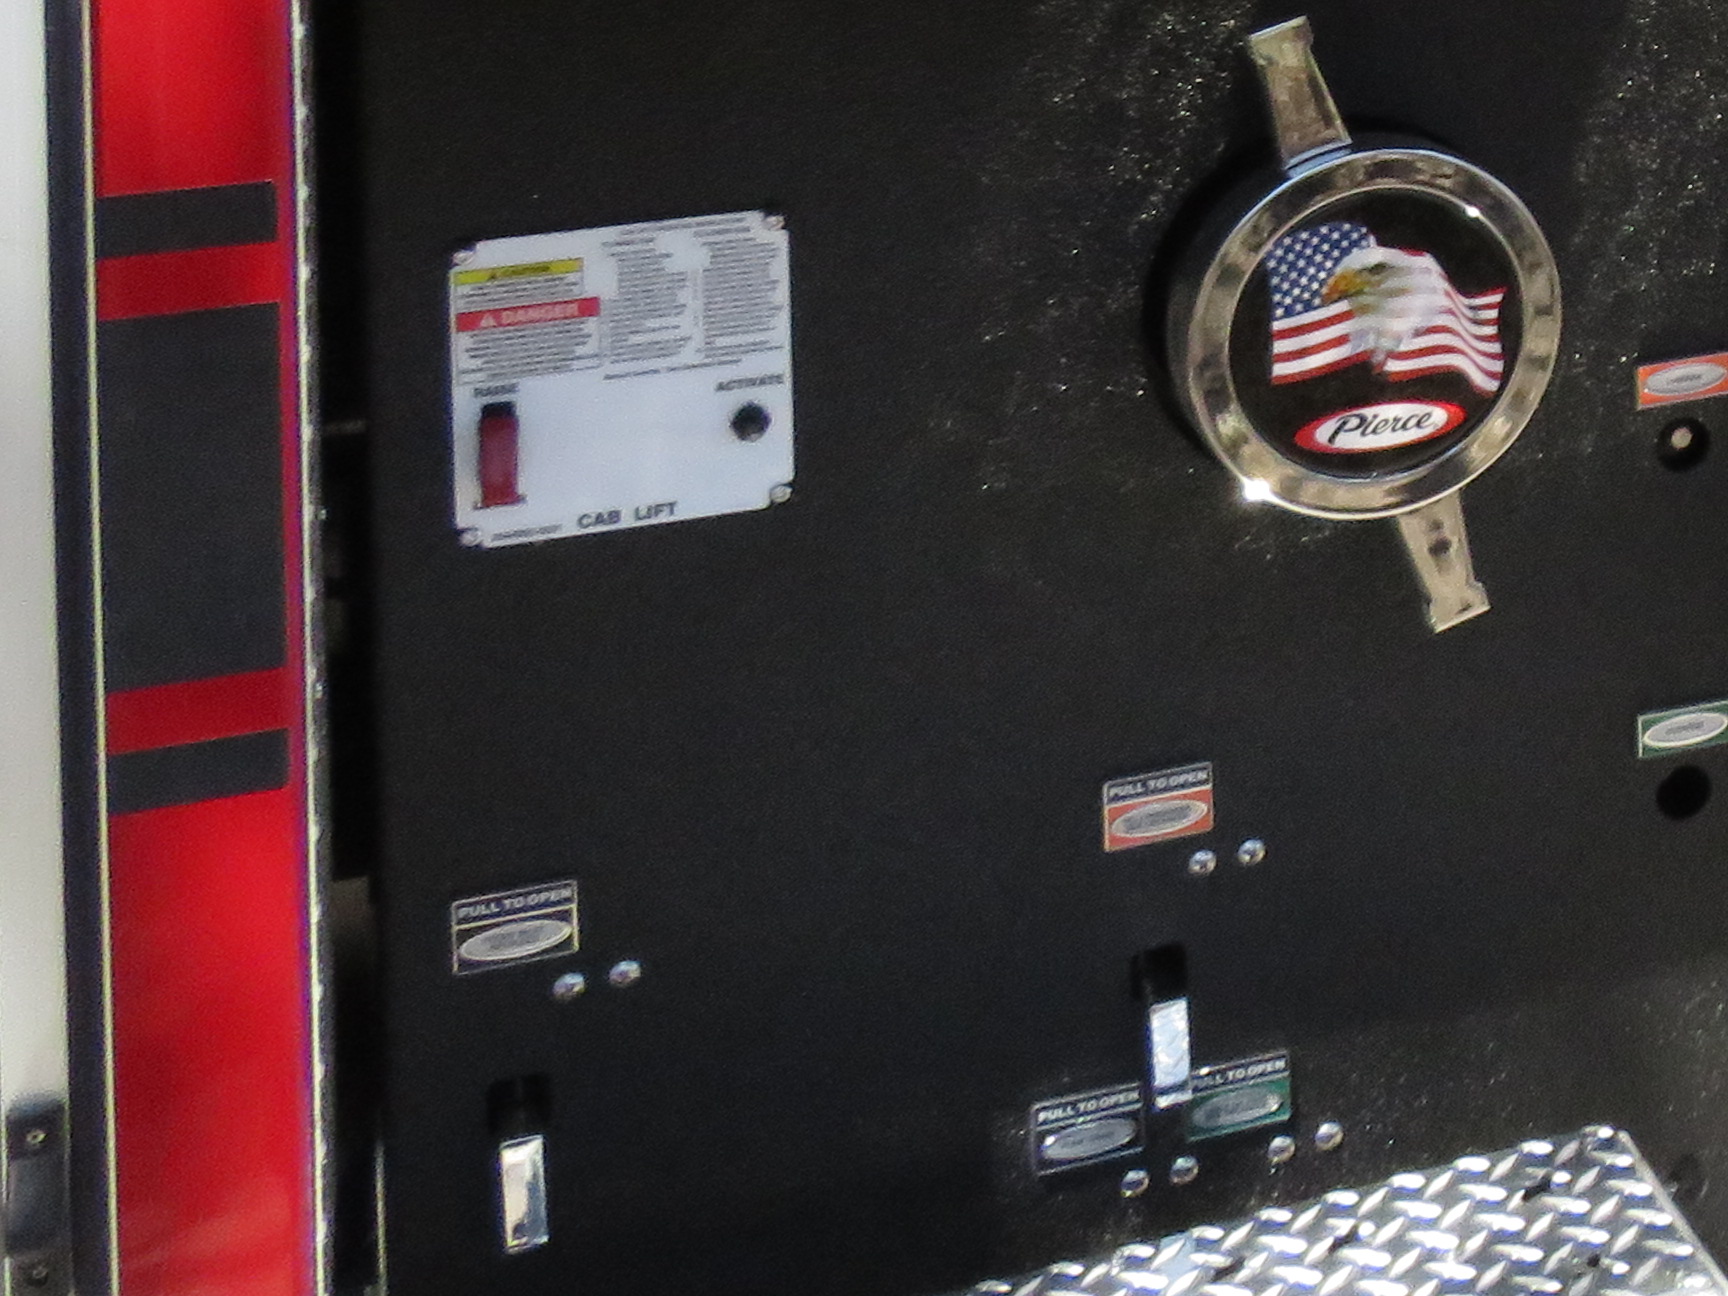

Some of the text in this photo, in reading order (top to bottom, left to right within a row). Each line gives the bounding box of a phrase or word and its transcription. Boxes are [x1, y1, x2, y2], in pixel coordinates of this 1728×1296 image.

[1327, 411, 1433, 445] Pierce
[577, 501, 679, 530] CAB LIFT
[1108, 781, 1146, 797] PULL
[1168, 770, 1209, 786] OPEN
[457, 888, 572, 919] PULL TO OPEN
[1246, 1058, 1286, 1075] OPEN
[1037, 1106, 1076, 1123] PULL
[1098, 1090, 1140, 1107] OPEN
